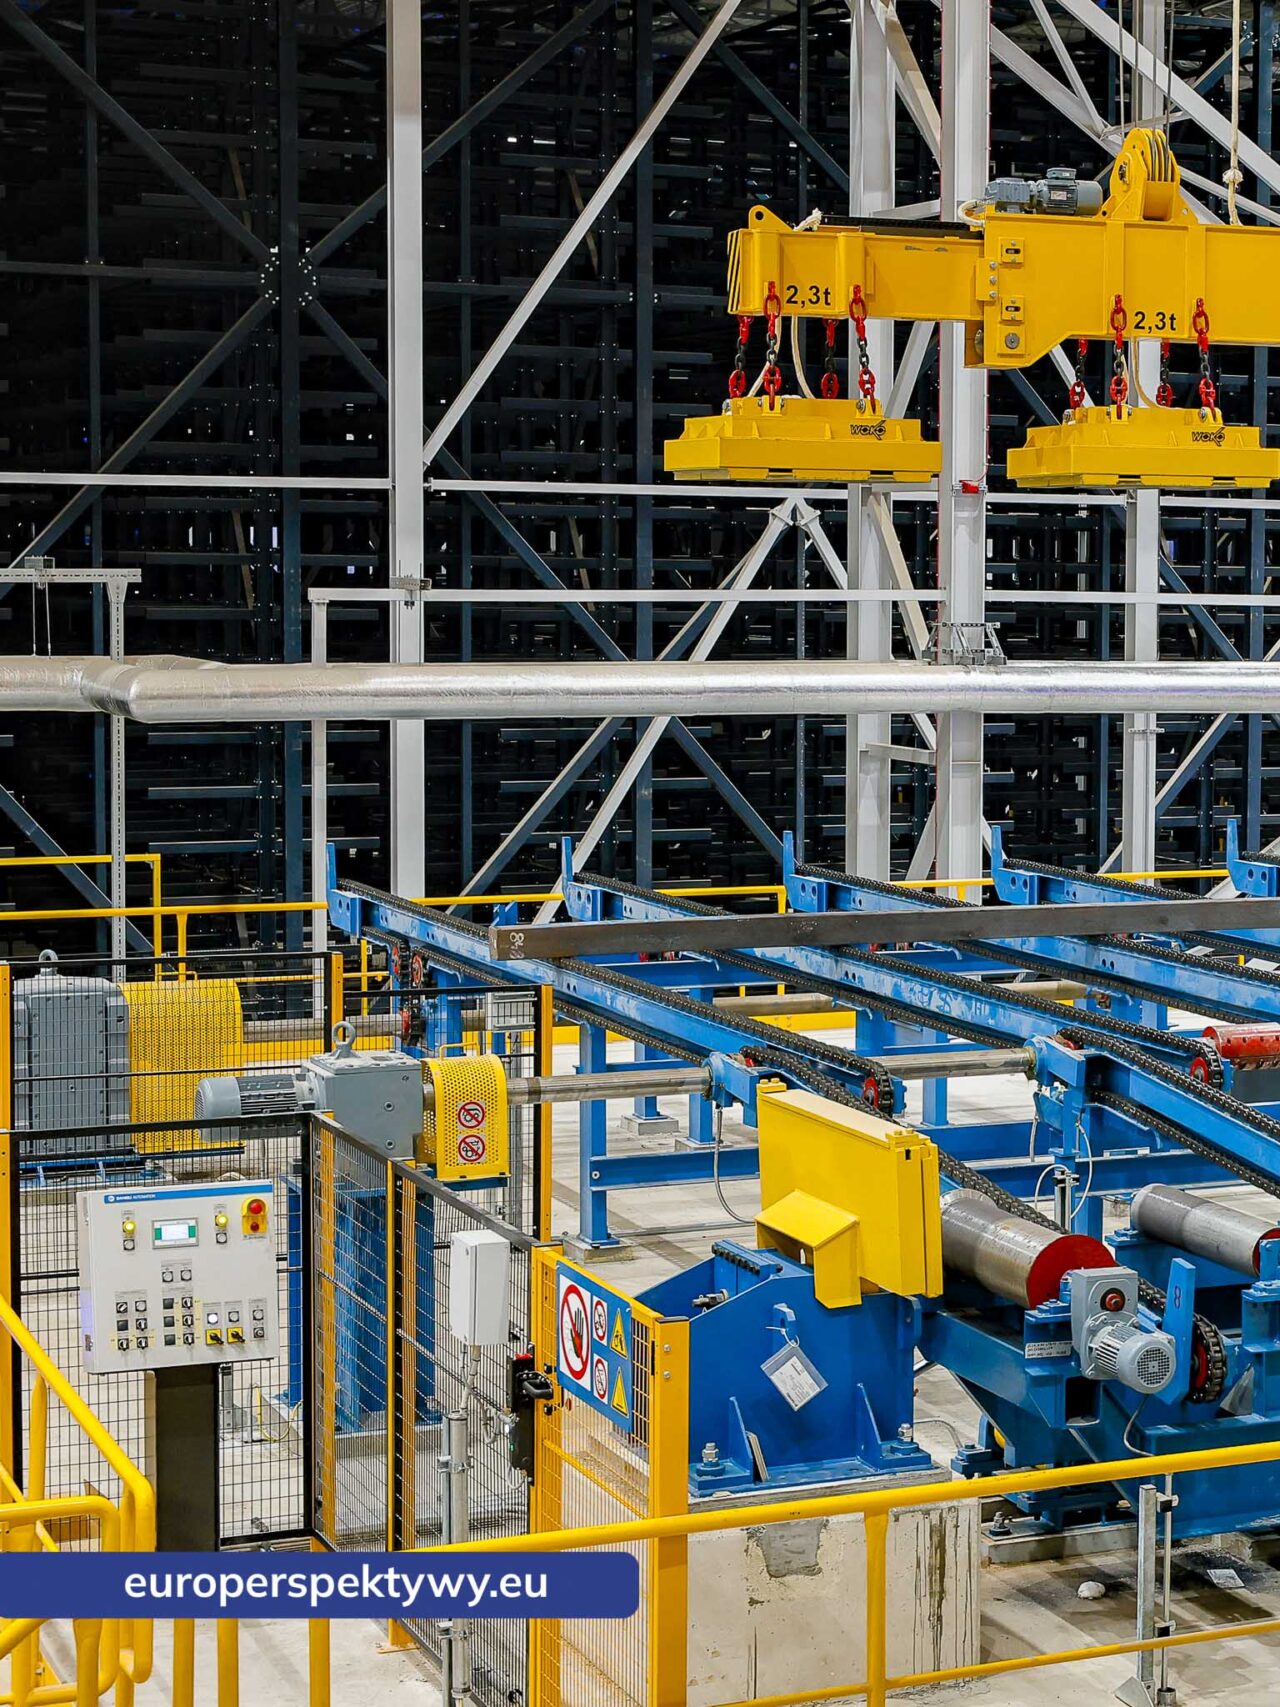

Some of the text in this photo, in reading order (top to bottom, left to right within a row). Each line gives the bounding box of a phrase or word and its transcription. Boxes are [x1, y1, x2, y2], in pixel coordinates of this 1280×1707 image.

[786, 284, 831, 308] 2,3t
[1134, 311, 1176, 334] 2,3t
[1174, 1285, 1182, 1310] 8
